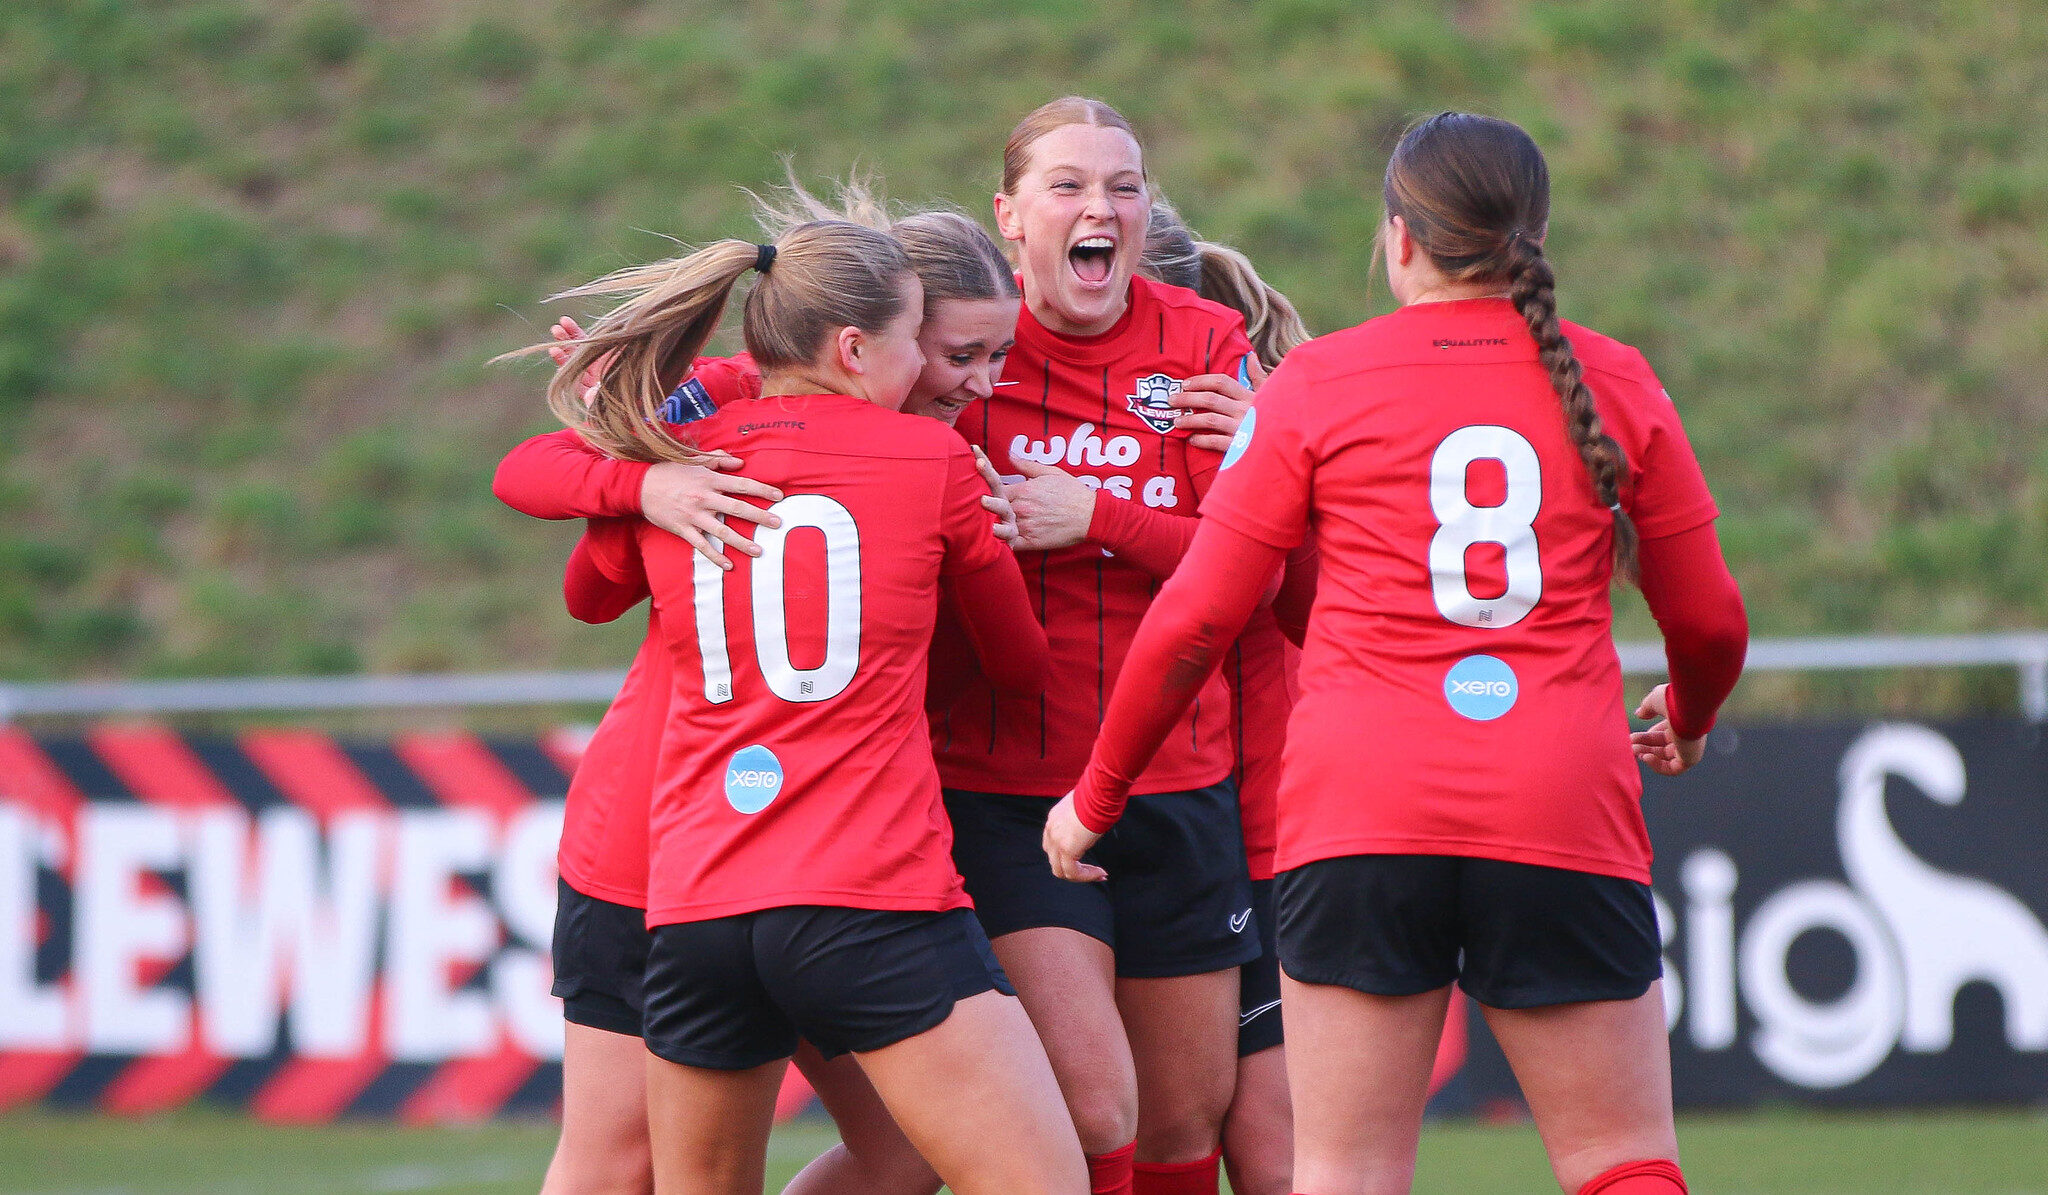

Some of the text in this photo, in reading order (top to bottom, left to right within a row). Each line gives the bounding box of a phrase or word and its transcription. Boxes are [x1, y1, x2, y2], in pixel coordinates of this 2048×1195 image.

[1138, 405, 1181, 419] LEWES
[1153, 420, 1169, 428] FC
[1009, 422, 1141, 467] who
[1142, 475, 1178, 506] a
[1429, 424, 1542, 628] 8
[693, 494, 861, 704] 10
[1451, 680, 1511, 697] xero
[731, 769, 777, 788] xero
